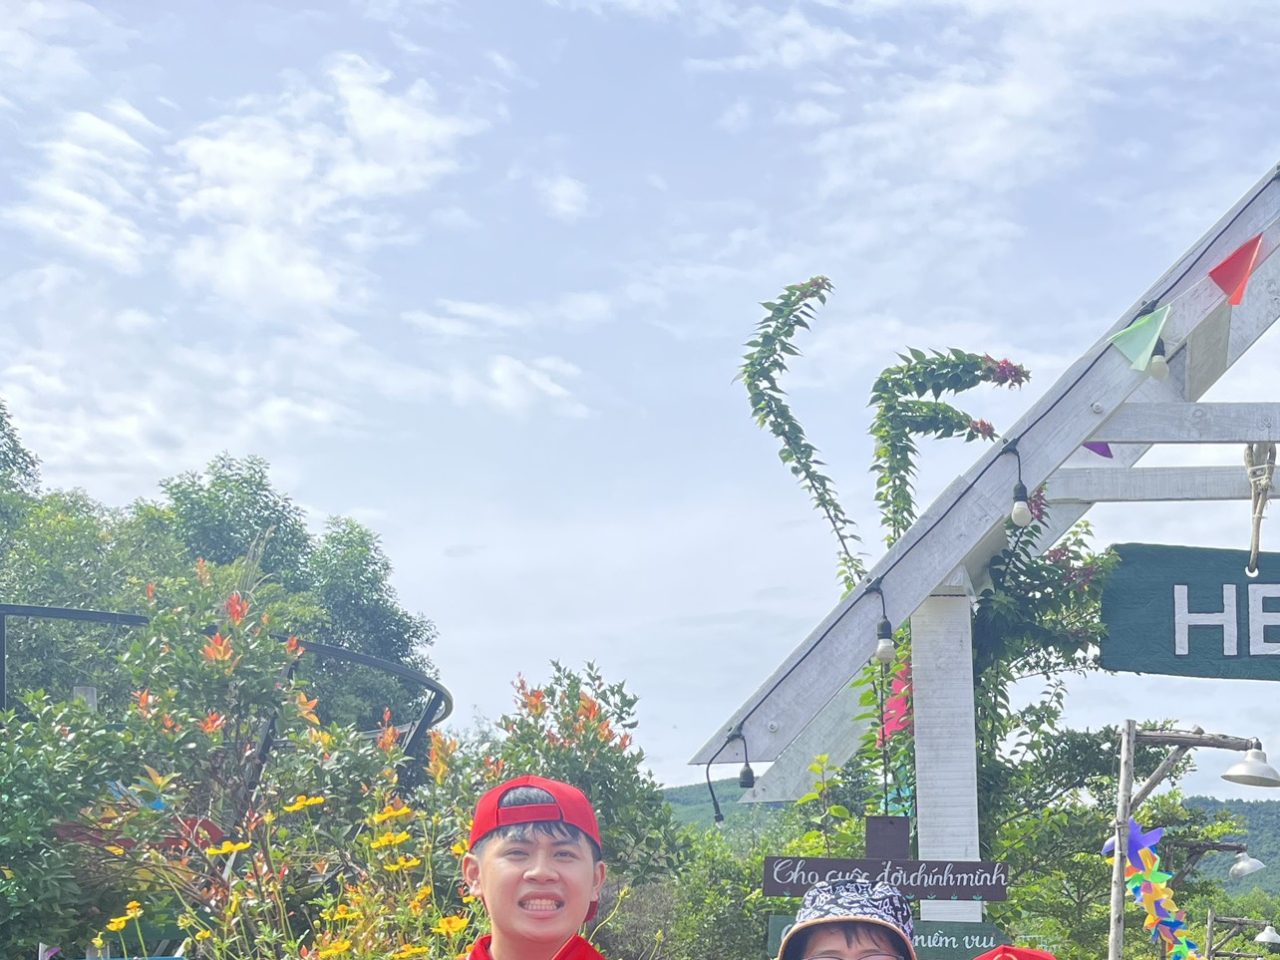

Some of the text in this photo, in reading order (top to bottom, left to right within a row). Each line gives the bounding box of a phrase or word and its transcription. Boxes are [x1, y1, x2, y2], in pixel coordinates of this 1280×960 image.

[773, 859, 819, 885] Cho
[909, 862, 955, 887] chính
[954, 862, 1008, 887] mình
[912, 930, 958, 949] niềm
